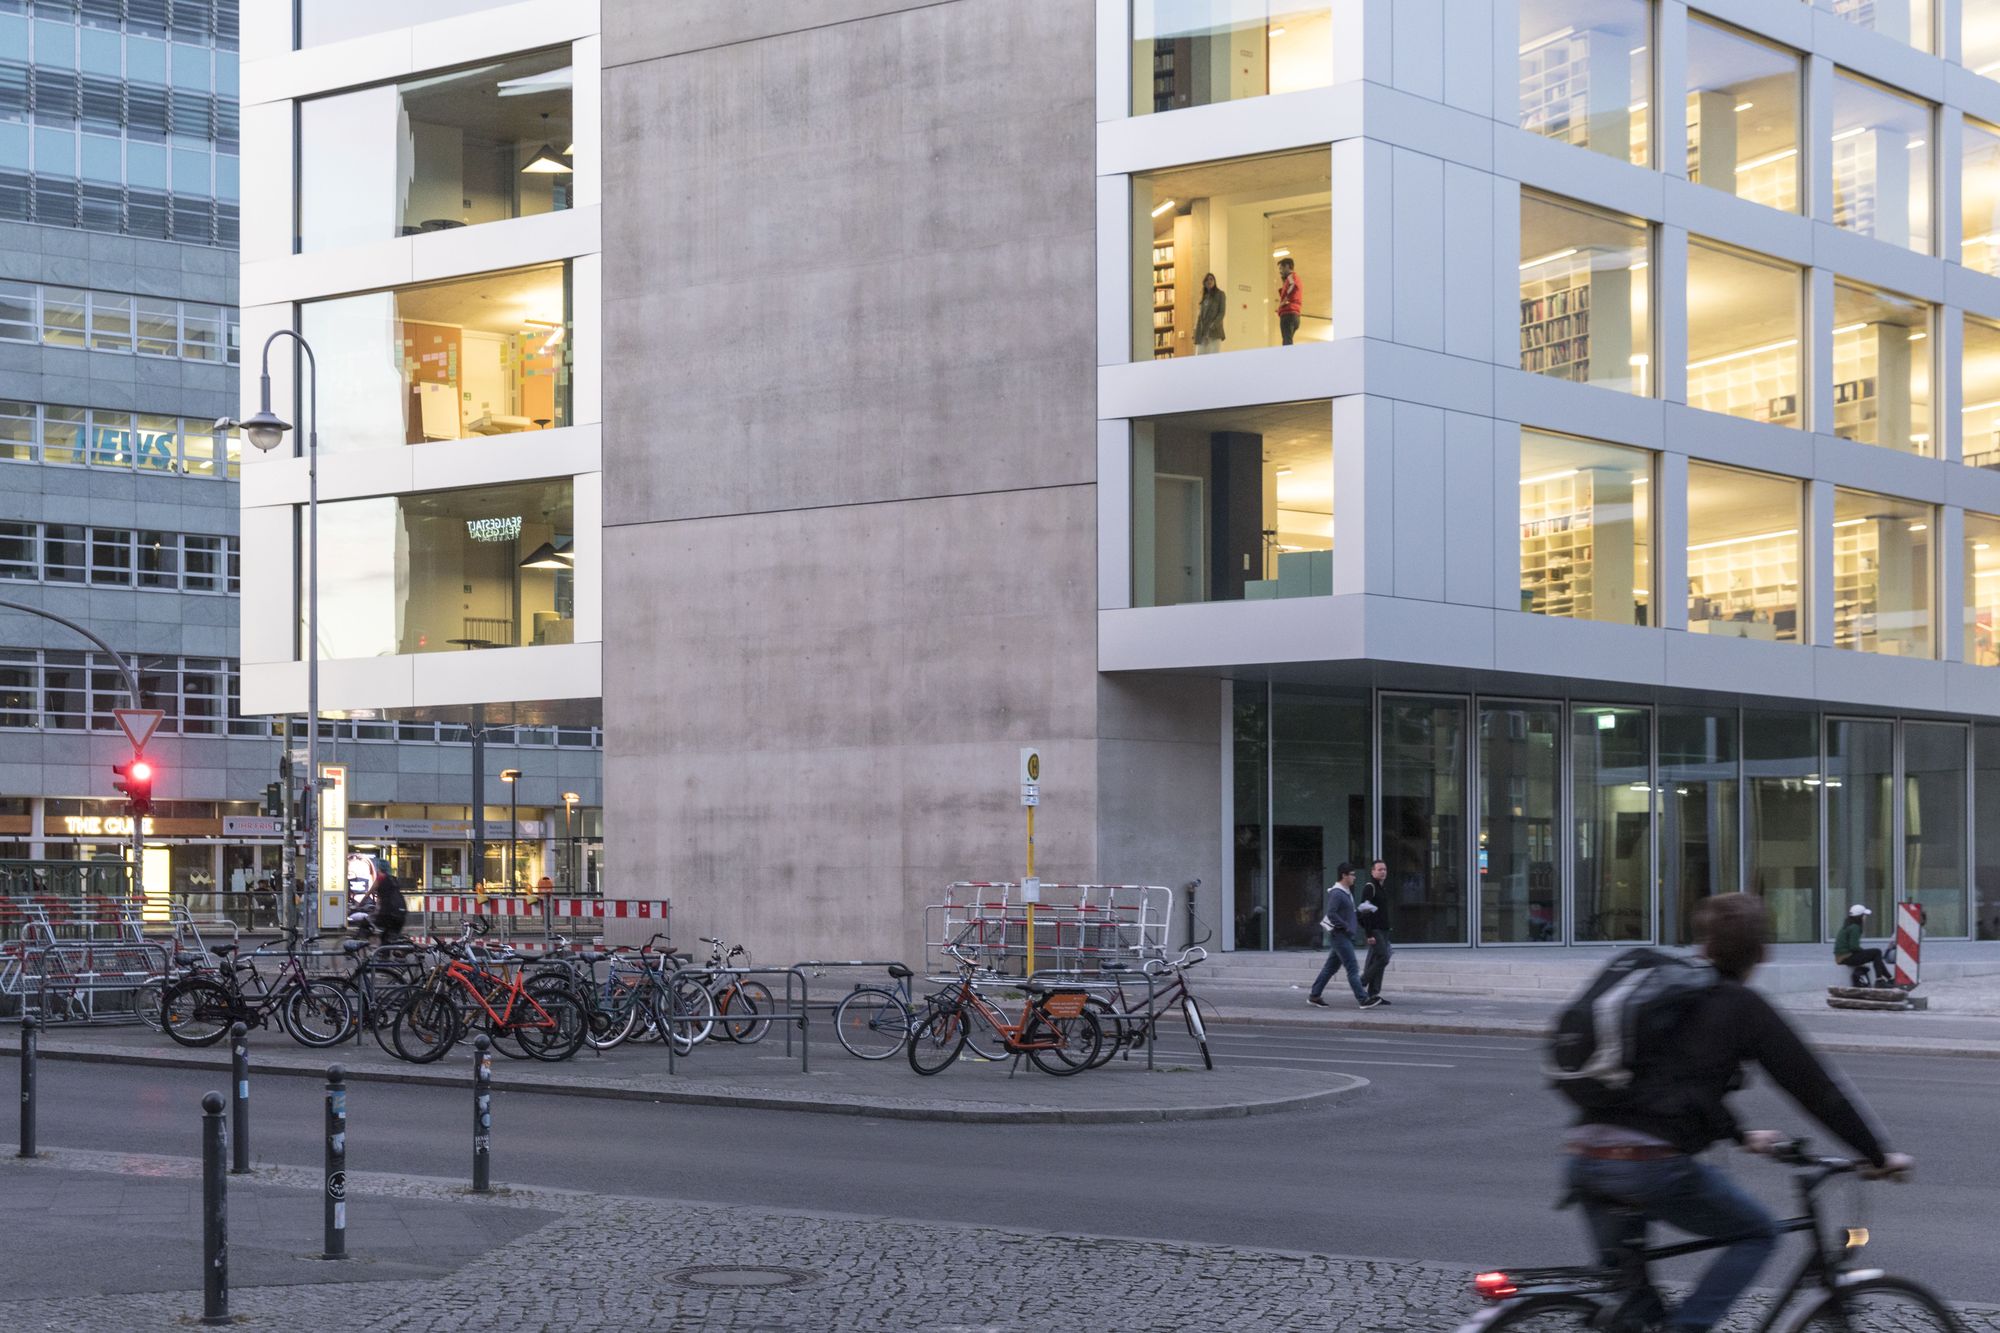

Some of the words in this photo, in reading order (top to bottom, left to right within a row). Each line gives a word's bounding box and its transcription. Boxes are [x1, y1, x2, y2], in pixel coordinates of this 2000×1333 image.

[73, 425, 176, 469] NEWS
[65, 816, 102, 834] THE
[104, 816, 154, 835] CUE
